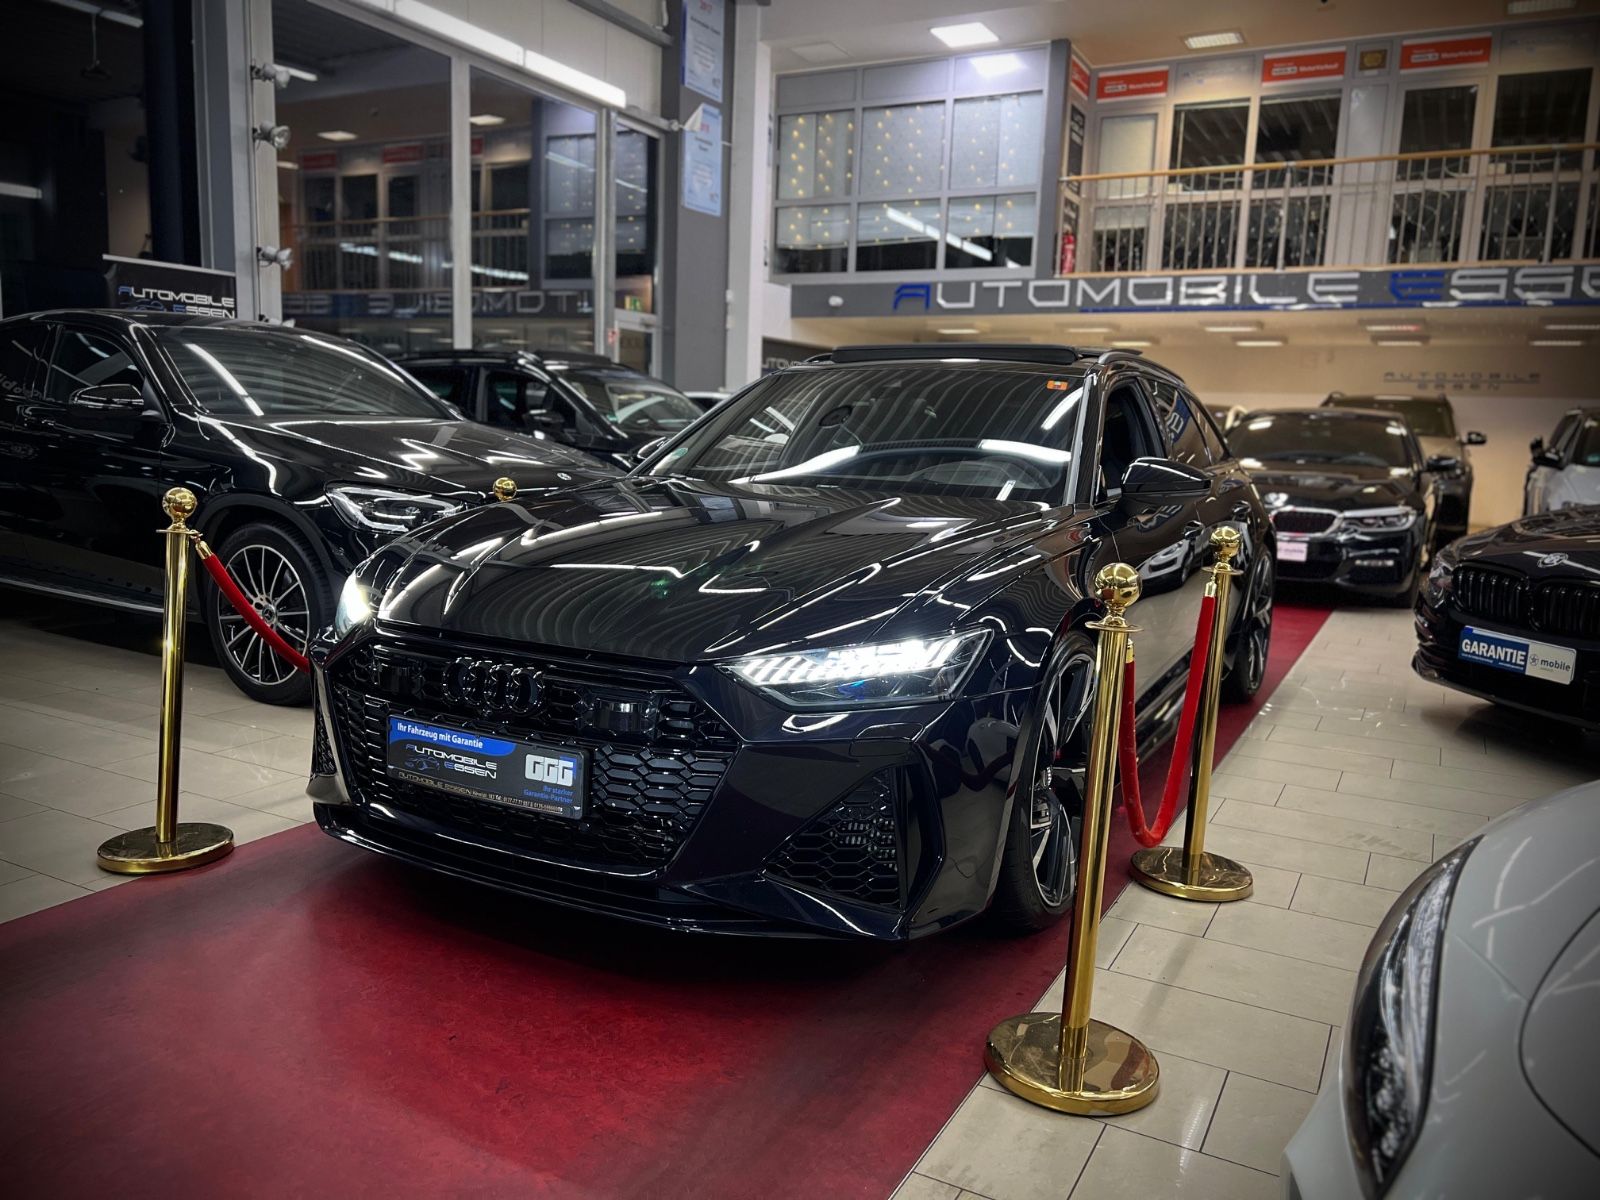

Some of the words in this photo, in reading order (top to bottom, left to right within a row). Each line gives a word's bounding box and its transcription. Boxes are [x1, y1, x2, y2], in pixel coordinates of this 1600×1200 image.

[118, 285, 235, 308] AUTOMOBILE
[893, 272, 1360, 310] AUTOMOBILE
[172, 304, 235, 319] ESSEN
[1461, 638, 1527, 666] GARANTIE
[1540, 657, 1571, 672] mobile
[397, 722, 407, 732] Ihr
[407, 724, 438, 741] Fahrzeug
[438, 732, 451, 742] mit
[451, 735, 484, 749] Garantie
[405, 743, 498, 770] AUTOMOBILE
[444, 761, 497, 780] ESSEN
[525, 754, 574, 787] GGG
